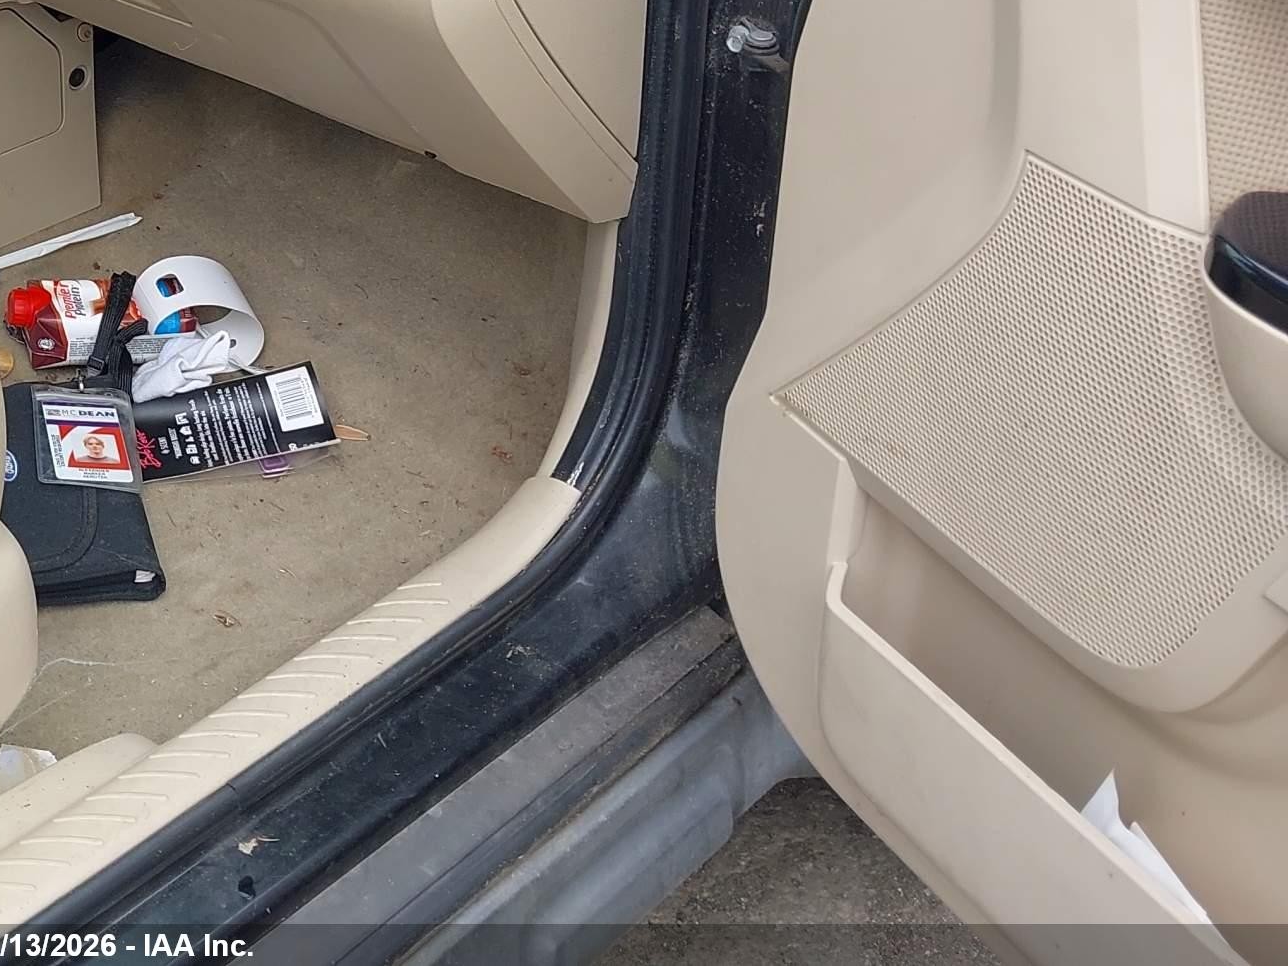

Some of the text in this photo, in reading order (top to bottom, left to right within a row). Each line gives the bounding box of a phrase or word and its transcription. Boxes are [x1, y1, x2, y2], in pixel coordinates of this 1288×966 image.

[60, 283, 77, 320] Premier
[72, 286, 87, 317] Protein
[78, 410, 115, 418] DEAN
